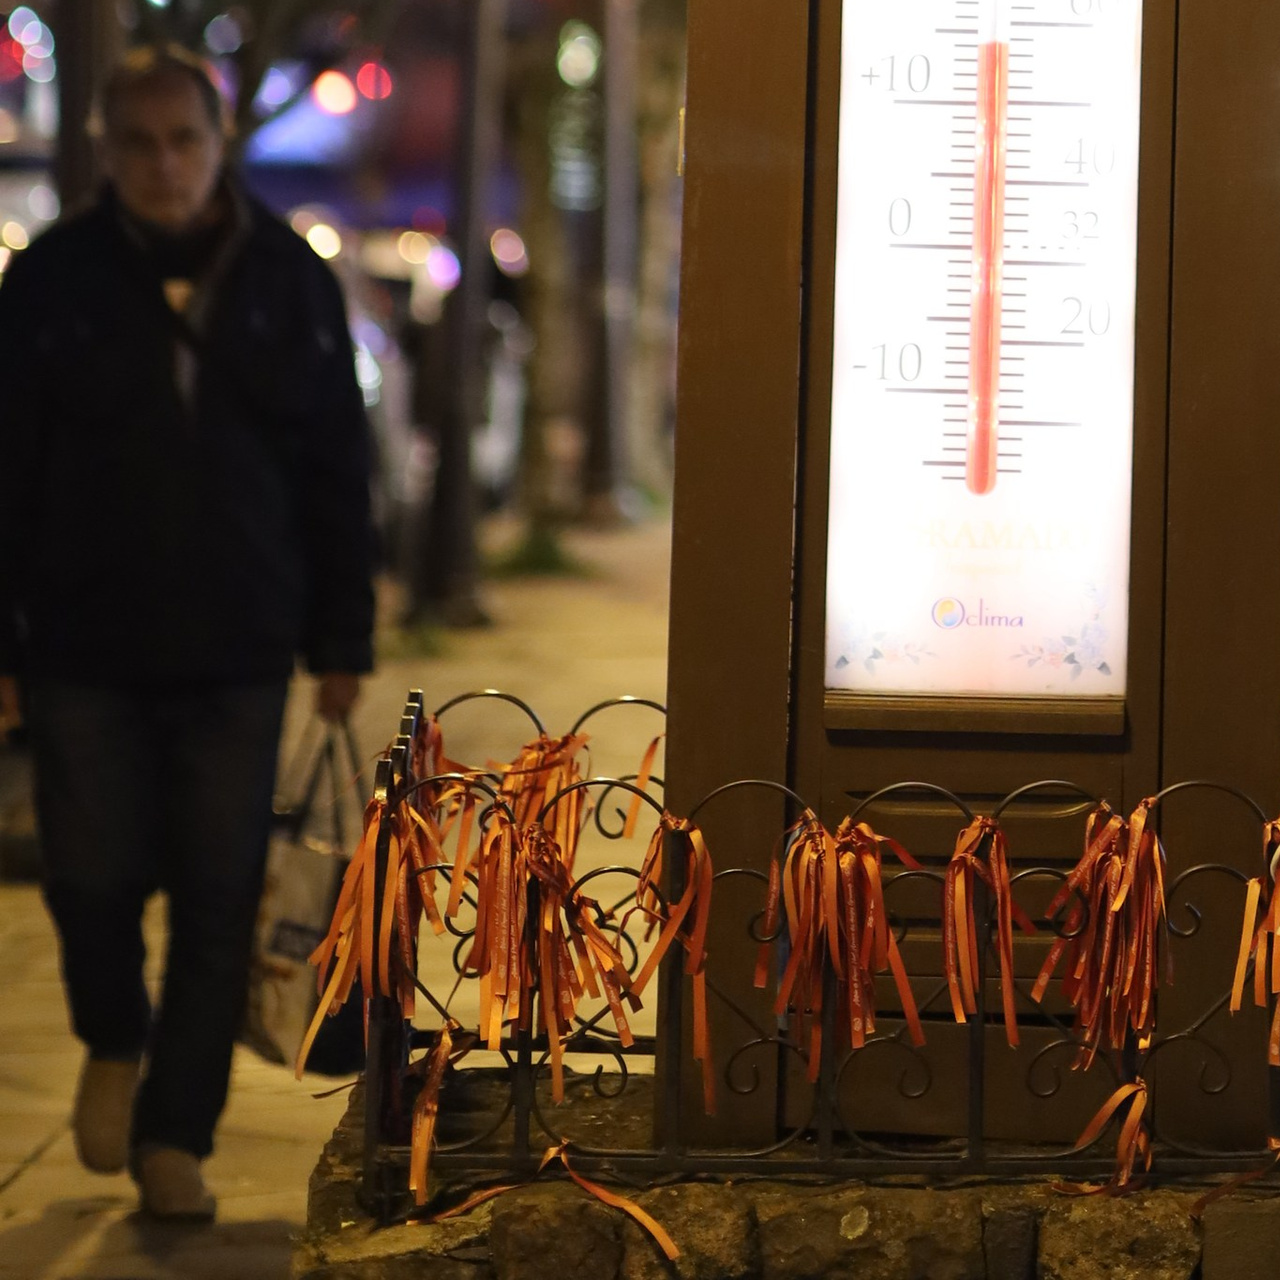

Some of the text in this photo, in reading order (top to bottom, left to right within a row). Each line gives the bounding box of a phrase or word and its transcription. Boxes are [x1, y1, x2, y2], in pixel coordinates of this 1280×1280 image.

[861, 53, 931, 93] +10
[1064, 137, 1116, 176] 40
[888, 197, 912, 236] 0
[1062, 210, 1099, 239] 32
[1060, 296, 1111, 336] 20
[852, 342, 922, 382] -10
